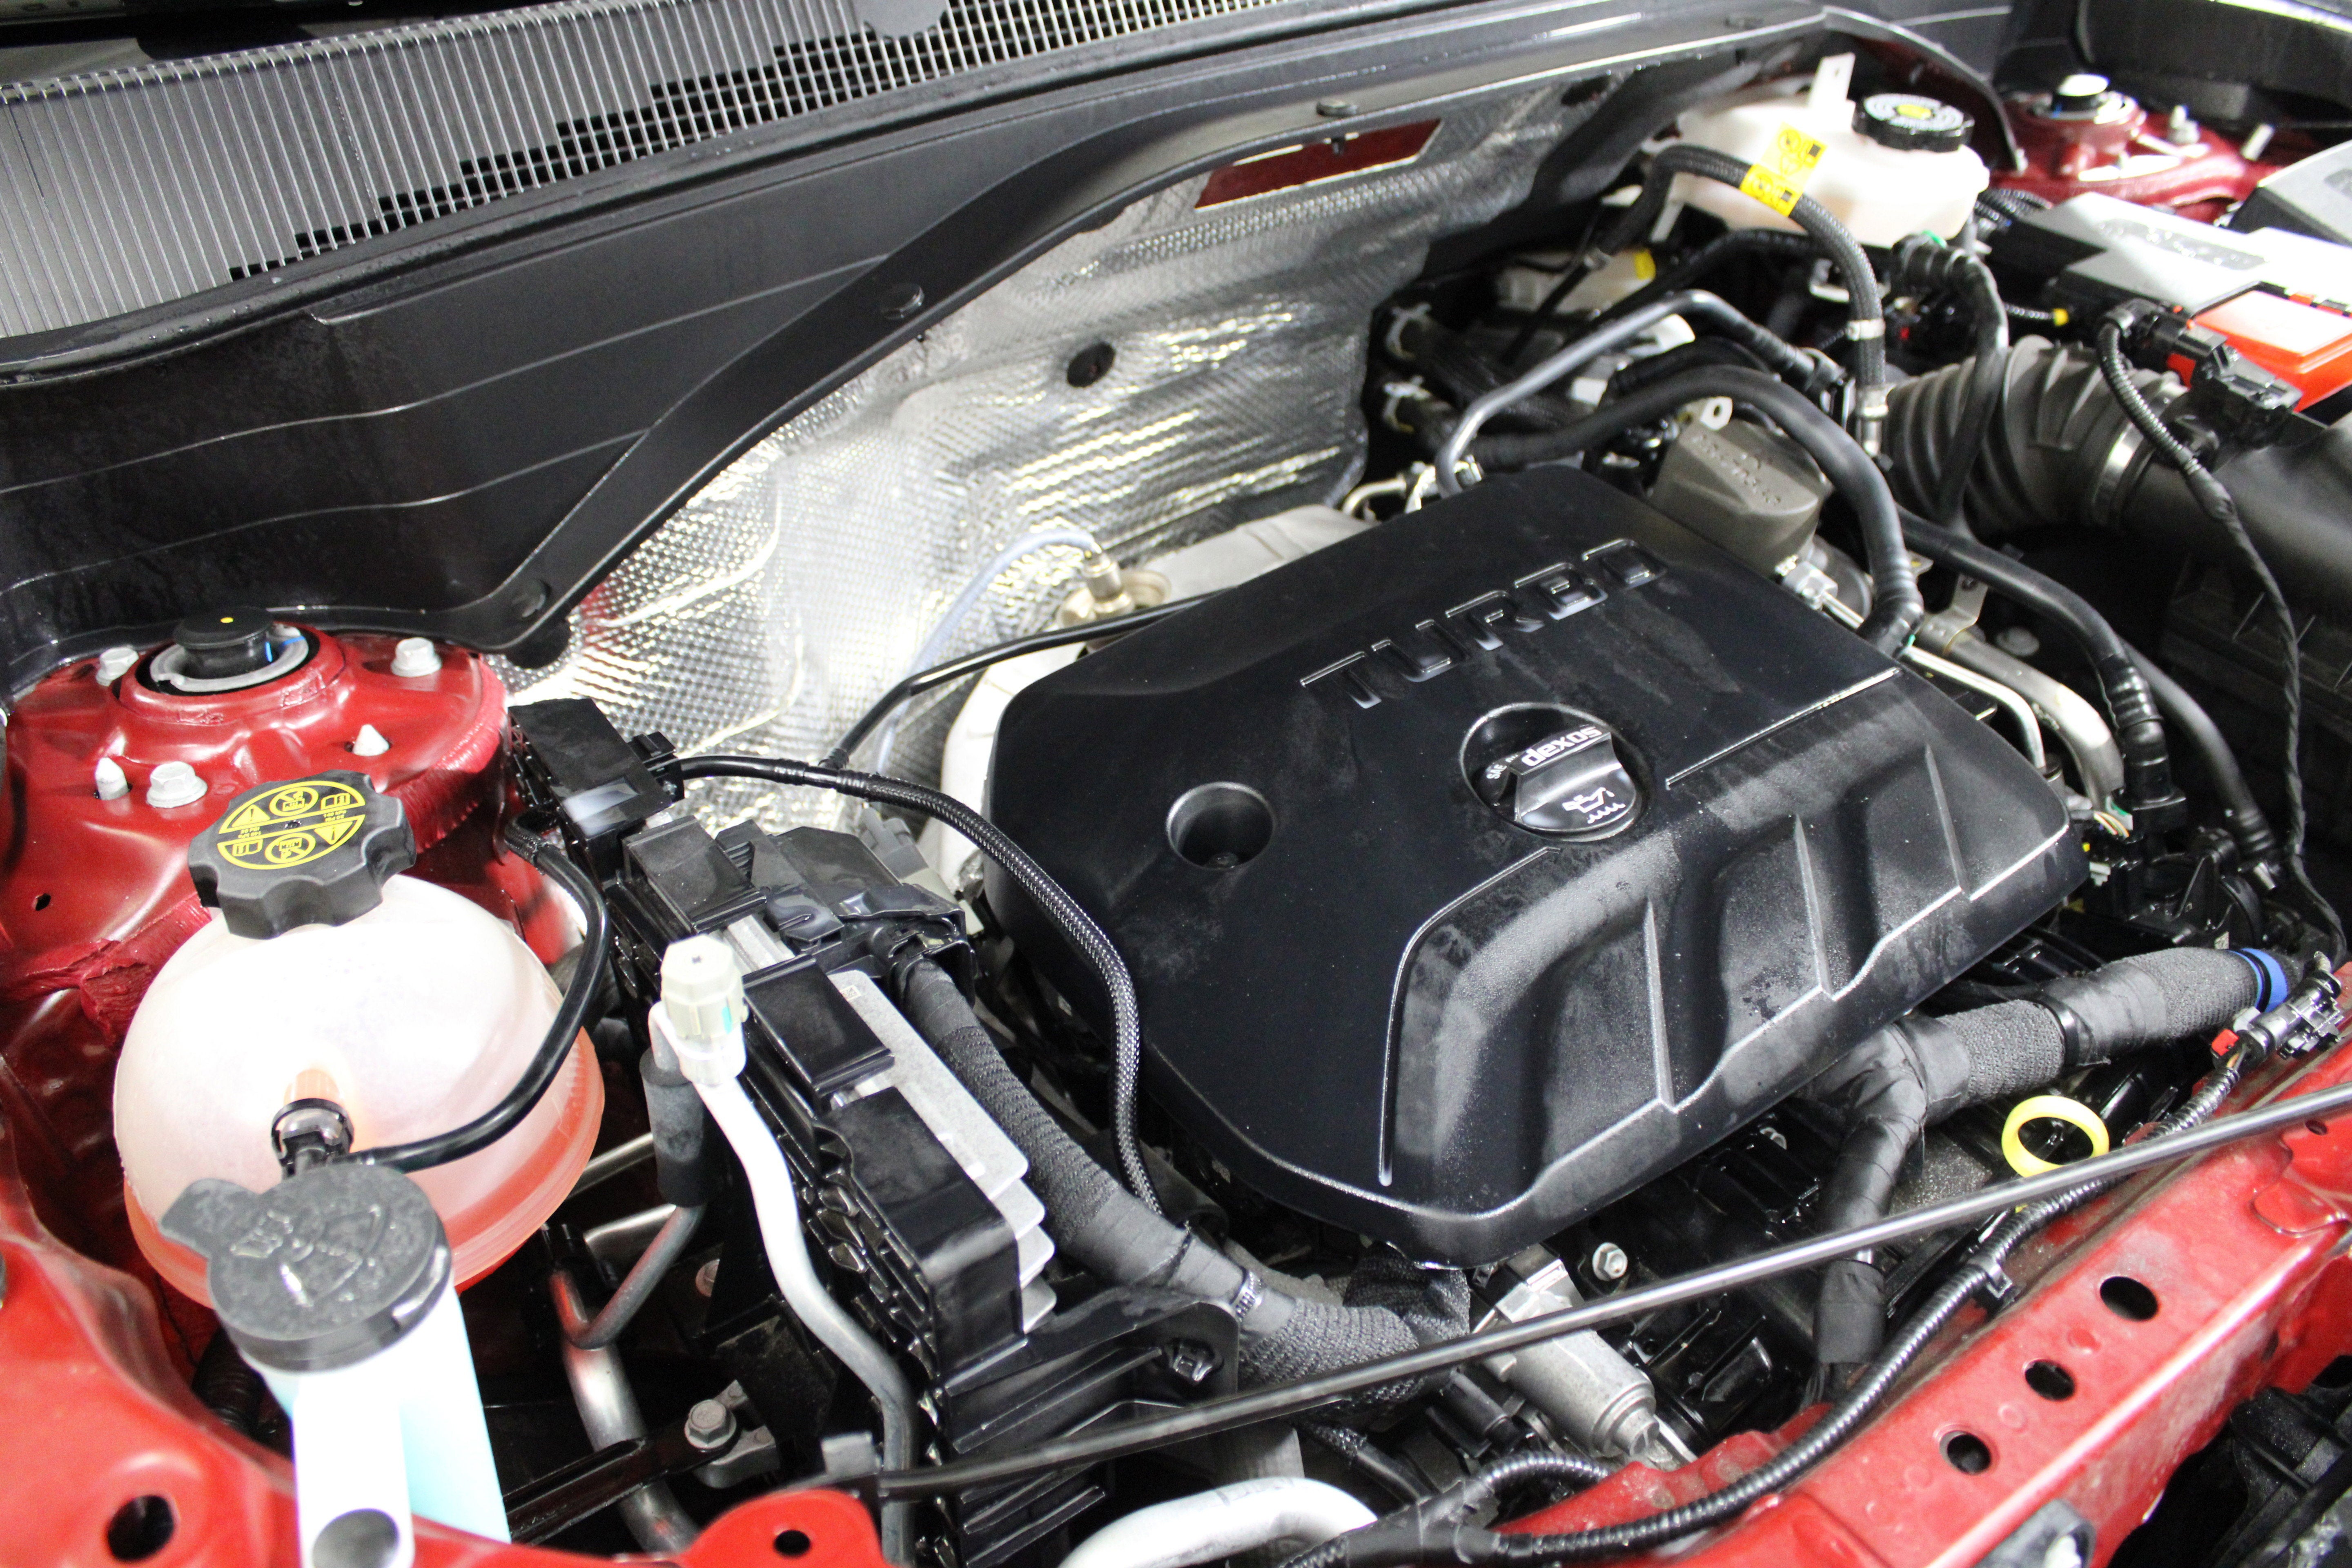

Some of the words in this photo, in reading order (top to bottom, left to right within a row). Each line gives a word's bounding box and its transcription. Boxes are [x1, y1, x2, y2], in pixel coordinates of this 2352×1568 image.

[1300, 538, 1668, 709] TURBO
[1521, 726, 1602, 766] dexos
[1486, 764, 1507, 779] SAE
